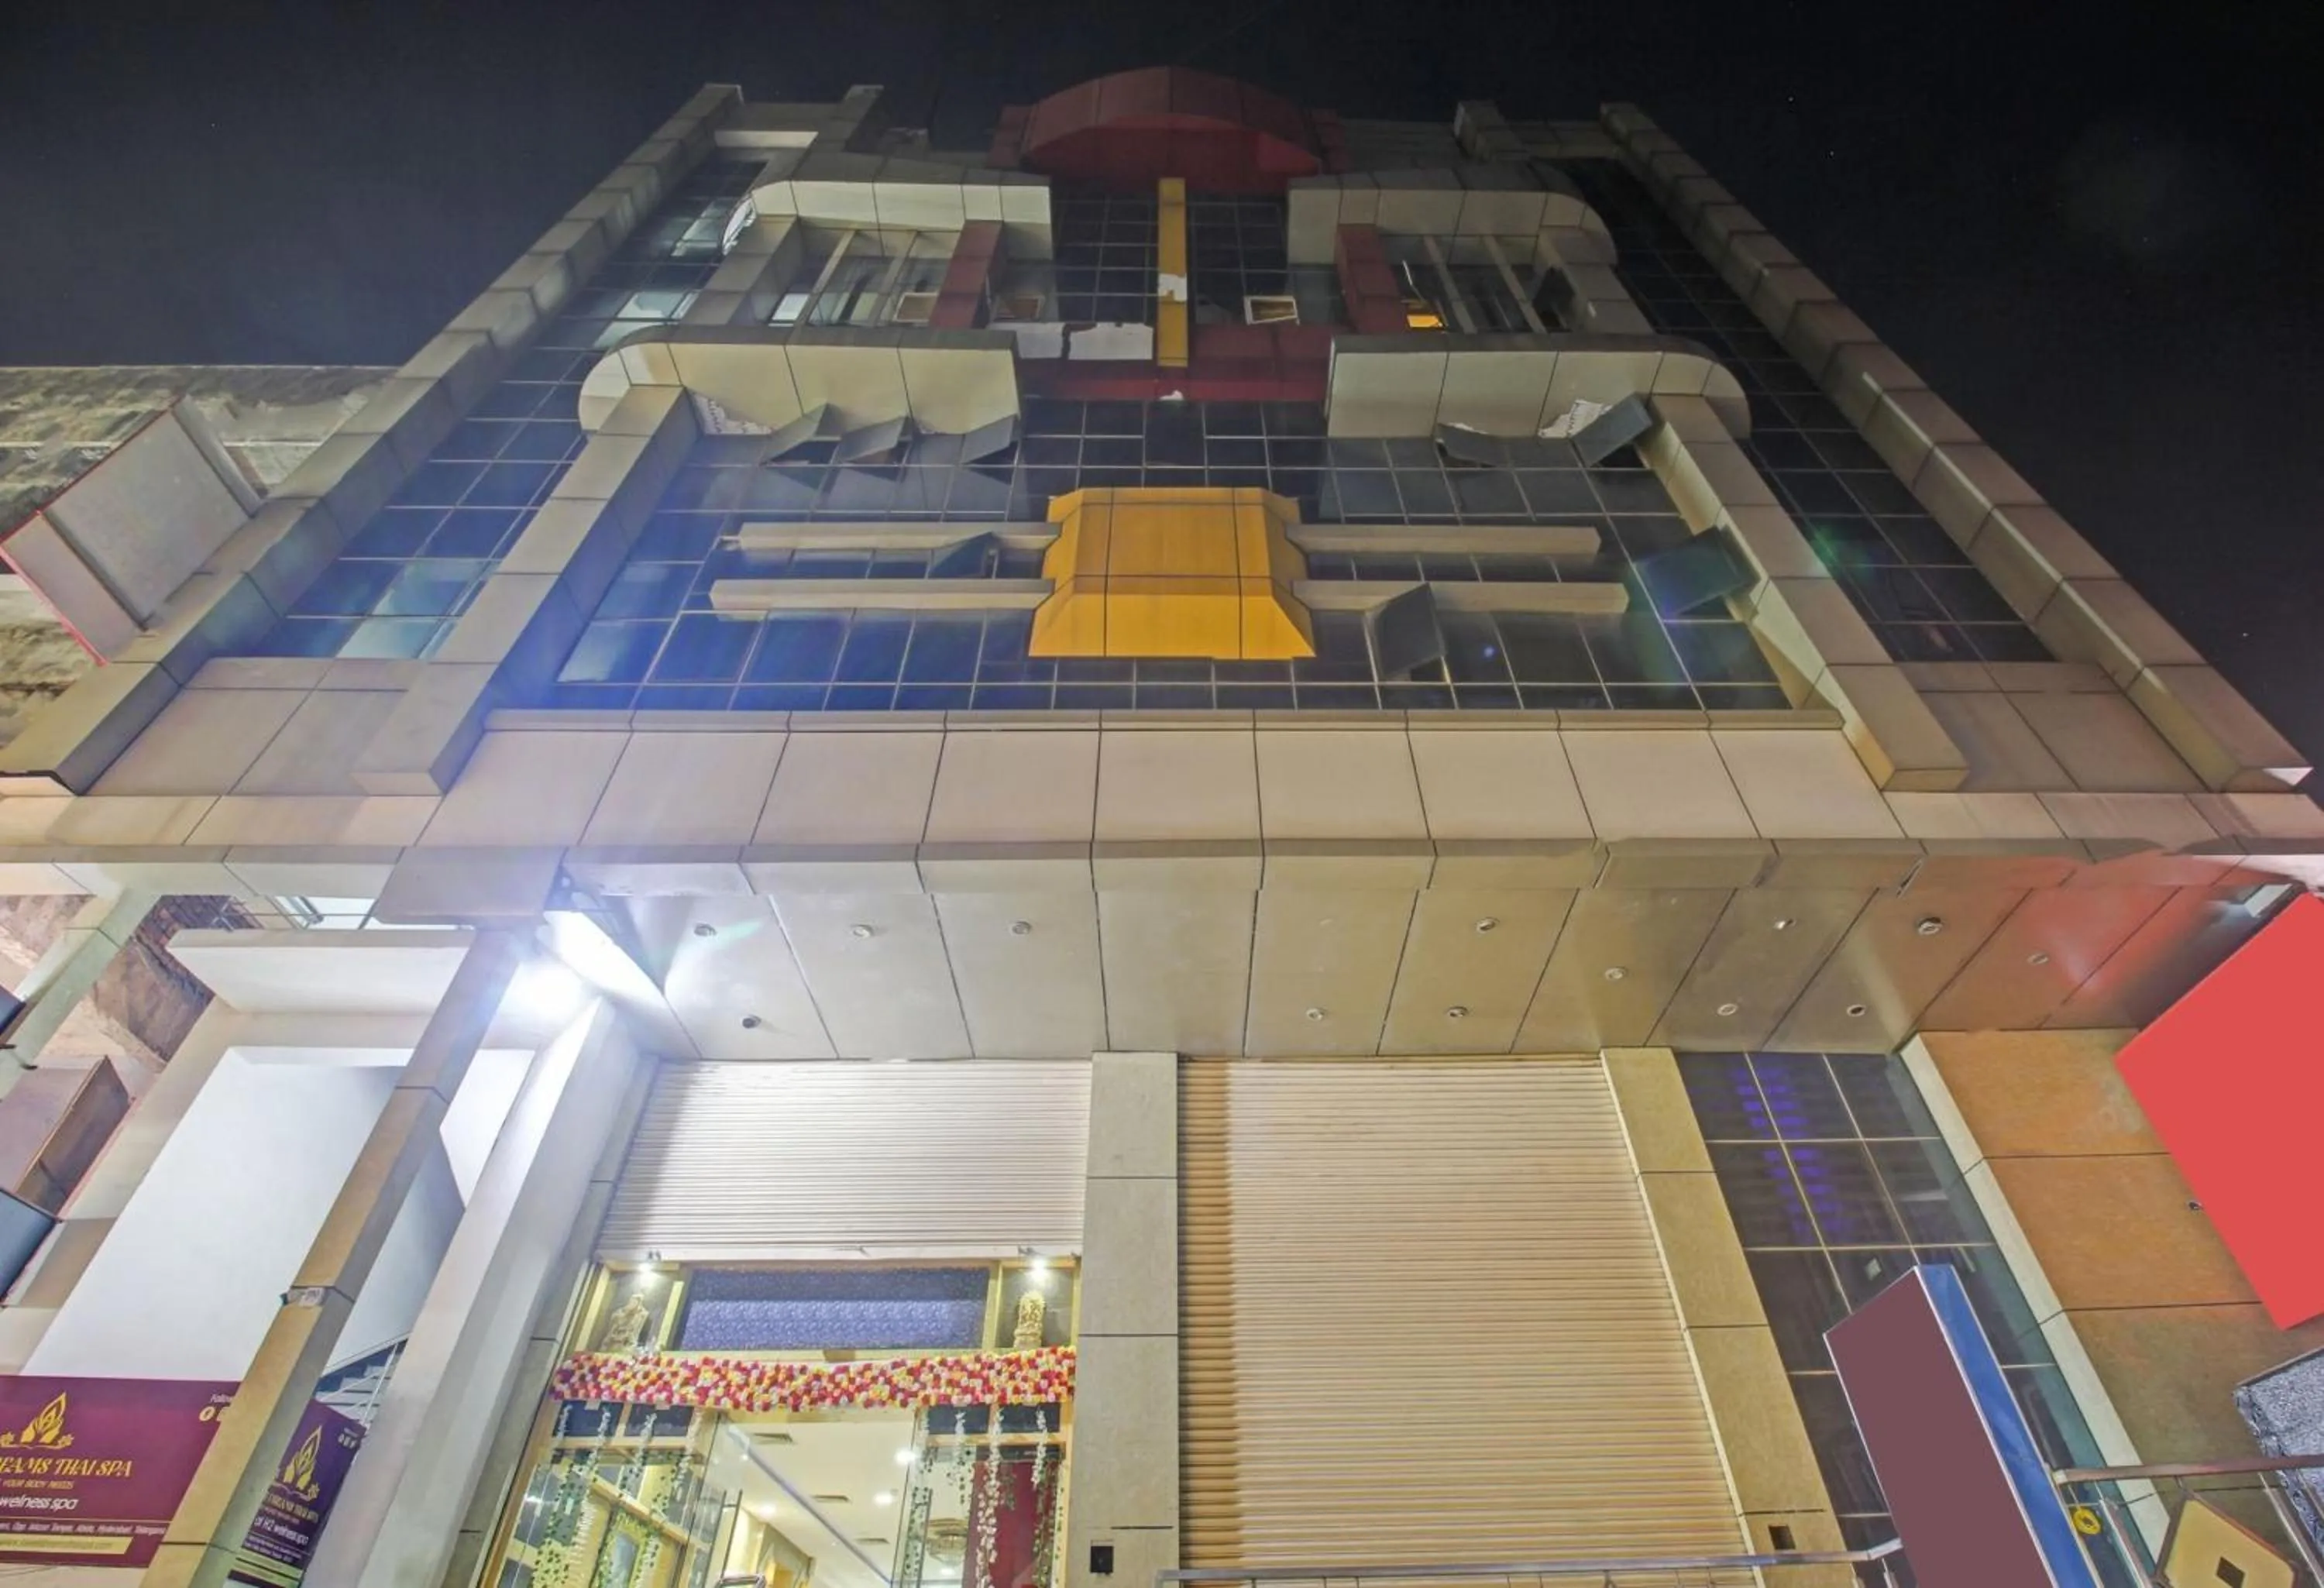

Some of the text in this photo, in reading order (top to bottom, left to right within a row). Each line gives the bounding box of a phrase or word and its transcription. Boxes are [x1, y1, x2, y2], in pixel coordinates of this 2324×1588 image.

[0, 1457, 132, 1477] EAMS THAI SPA
[50, 1497, 79, 1512] spa
